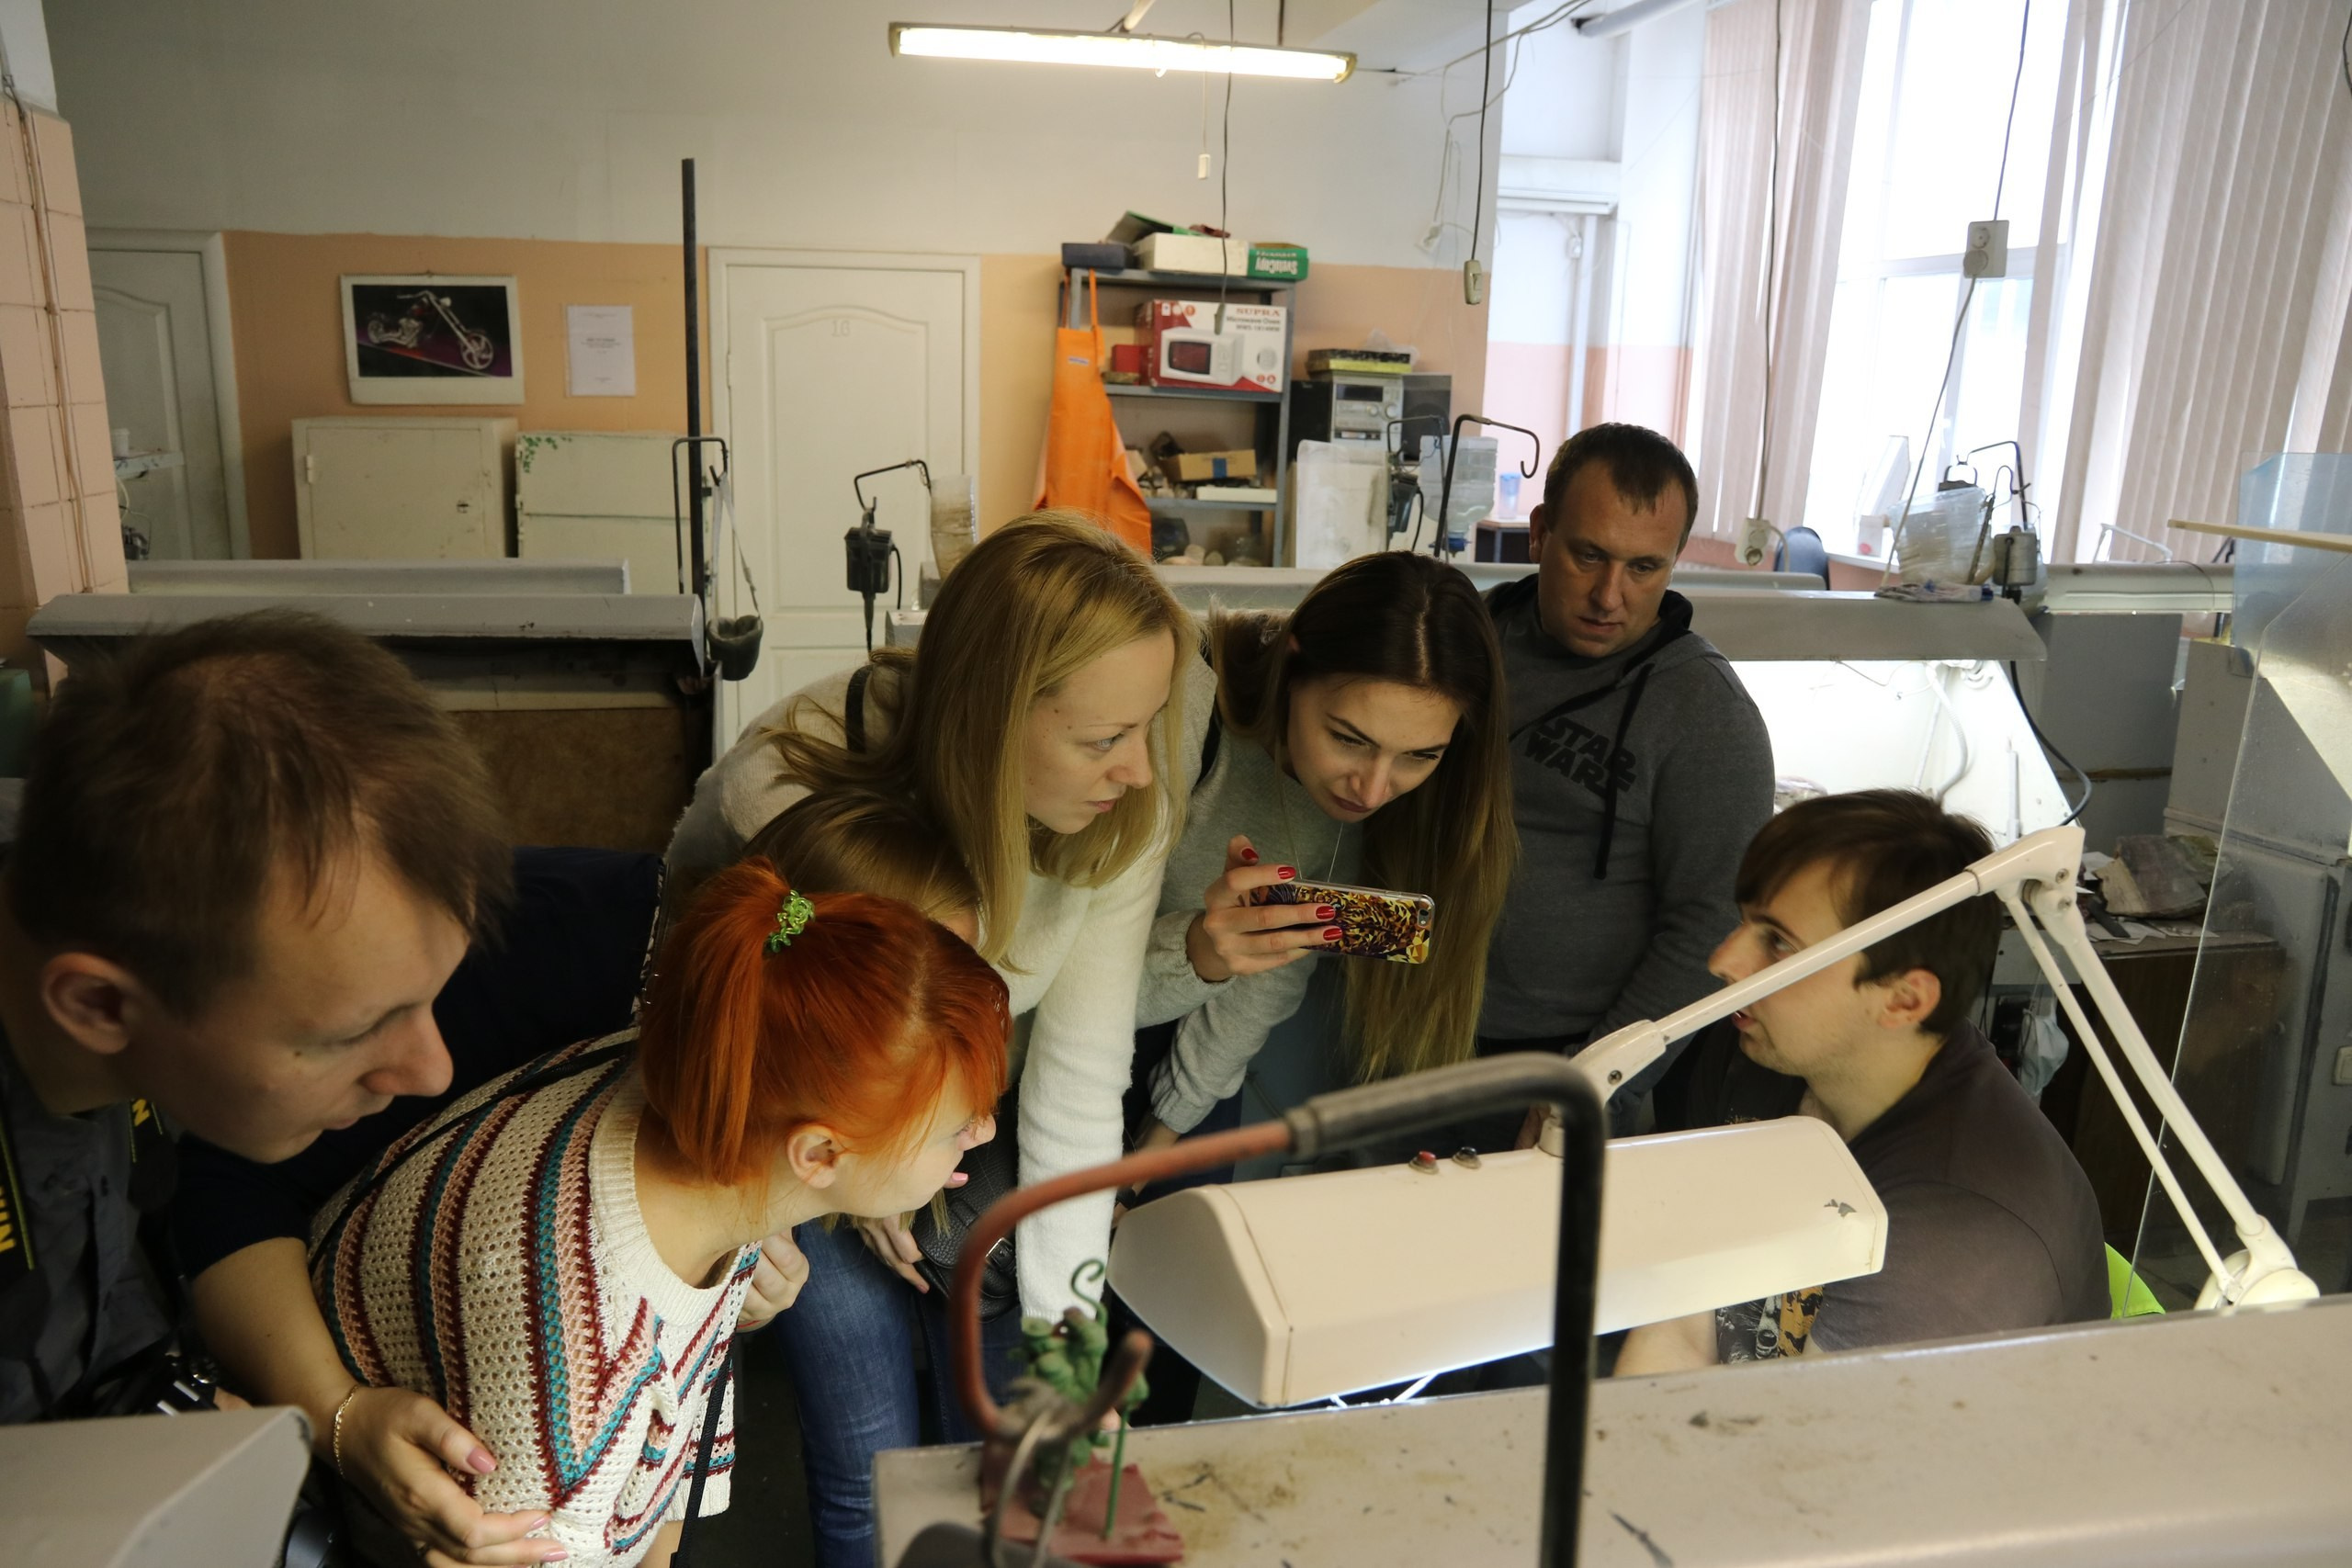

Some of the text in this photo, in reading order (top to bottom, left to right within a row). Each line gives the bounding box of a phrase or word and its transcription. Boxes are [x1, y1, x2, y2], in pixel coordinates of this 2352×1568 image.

[1236, 308, 1280, 317] SUPRA
[1227, 316, 1261, 324] Microwave
[1535, 716, 1636, 784] STAR
